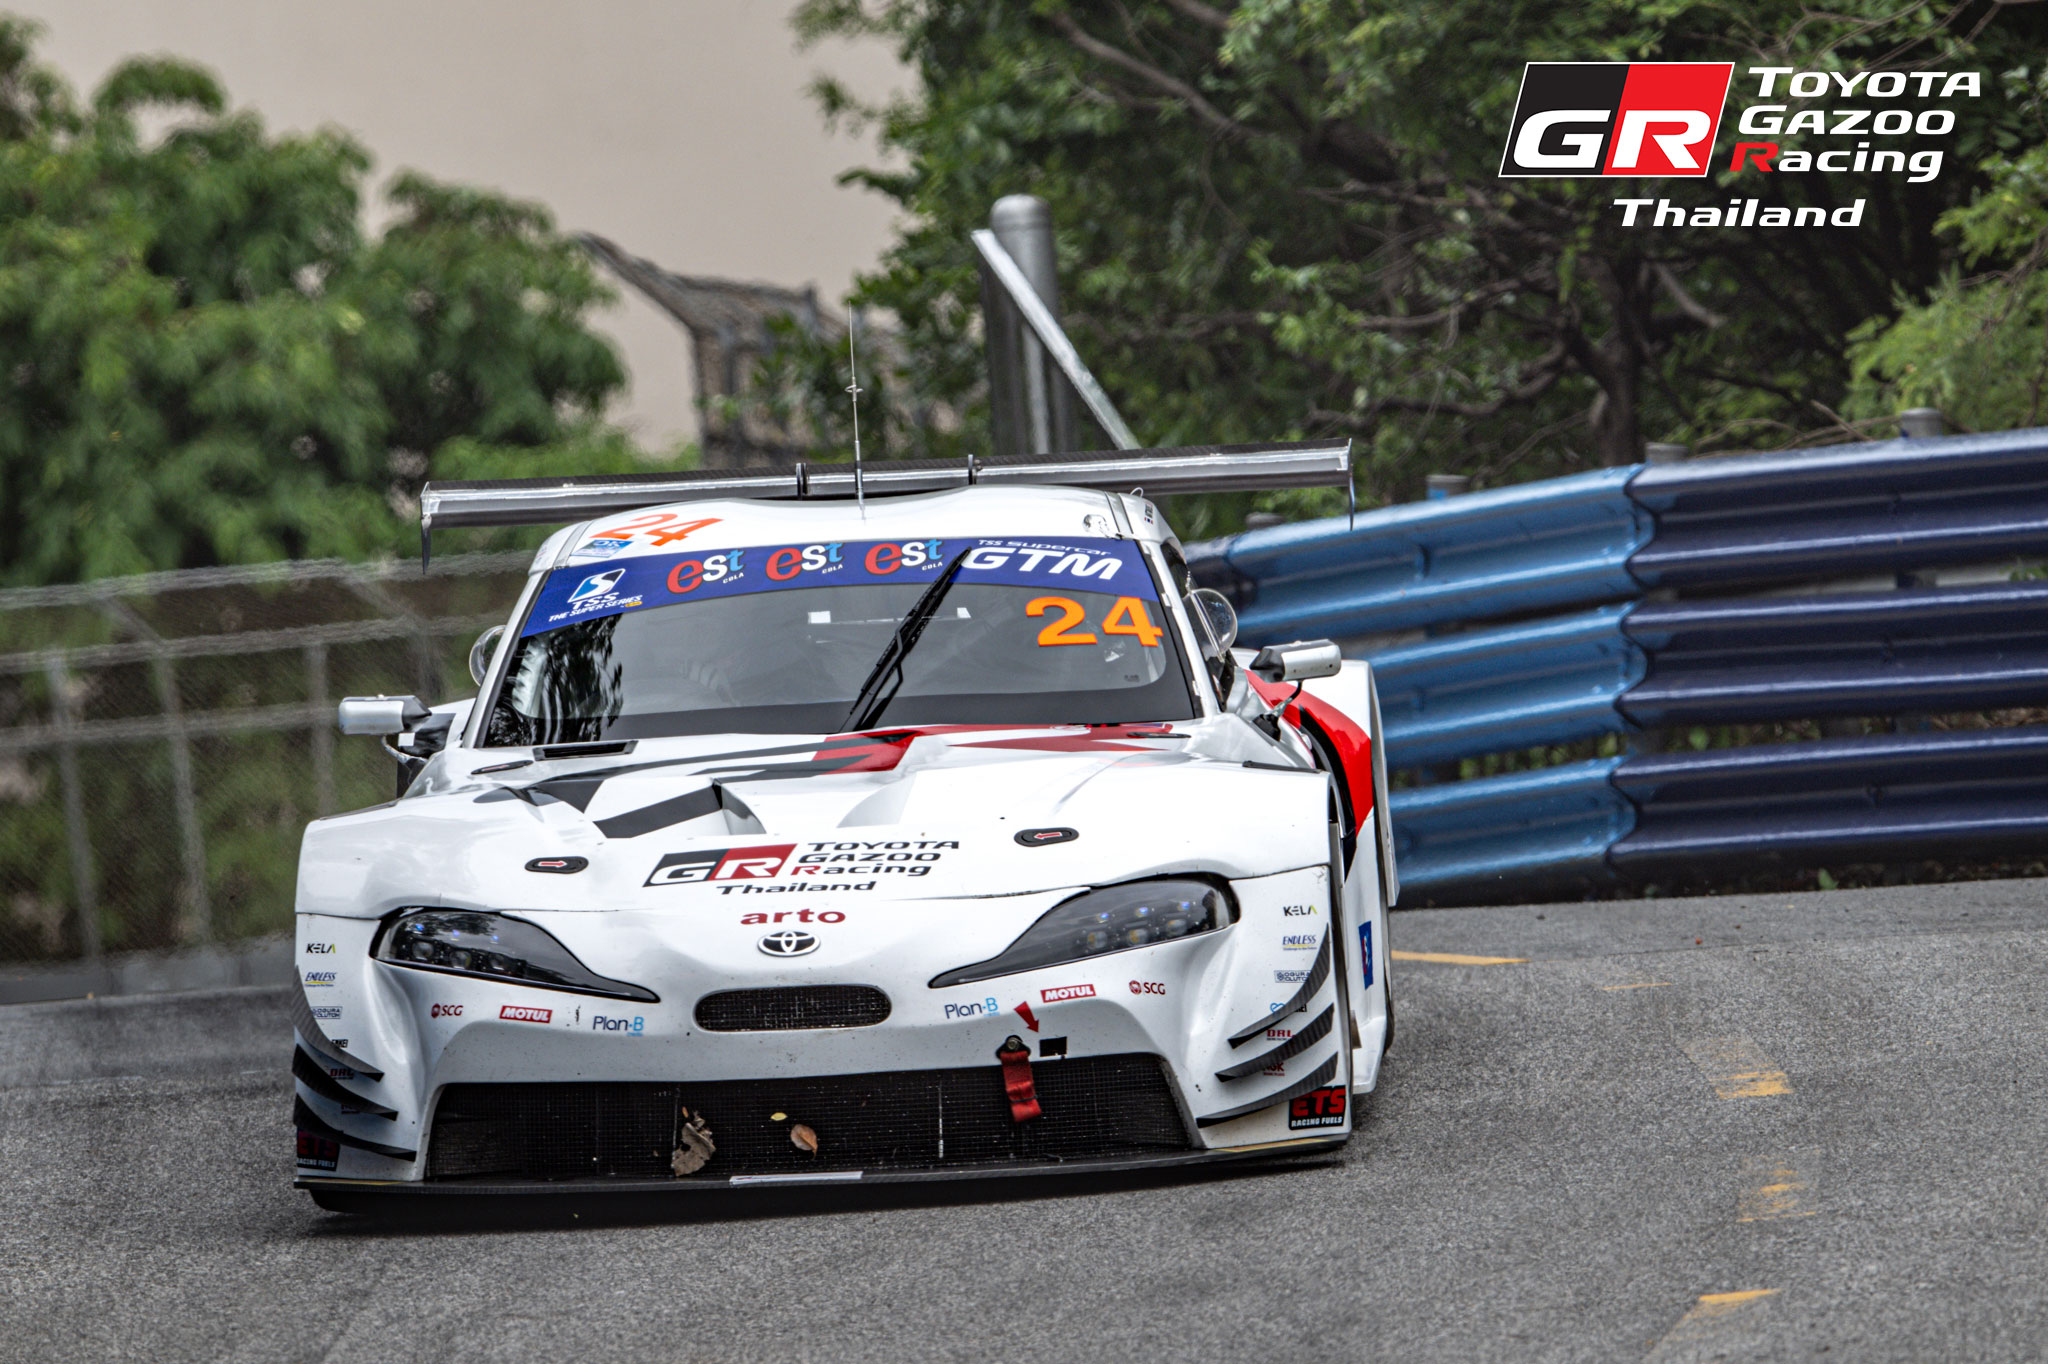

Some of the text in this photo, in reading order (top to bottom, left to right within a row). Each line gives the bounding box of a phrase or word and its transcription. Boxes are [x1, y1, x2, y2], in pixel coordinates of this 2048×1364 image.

[588, 513, 724, 547] 24
[765, 541, 846, 581] est
[864, 538, 944, 575] est
[960, 546, 1123, 580] GTM
[666, 548, 746, 594] est
[548, 611, 570, 622] THE
[569, 602, 605, 617] SUPER
[604, 595, 643, 609] SERIES
[572, 592, 620, 610] TSS
[1025, 596, 1164, 647] 24
[807, 841, 960, 852] TOYOTA
[798, 852, 942, 864] GAZOO
[649, 857, 782, 885] GR
[791, 863, 932, 877] Racing
[716, 881, 877, 895] Thailand
[740, 908, 846, 925] arto
[1283, 905, 1317, 916] KELA
[1282, 935, 1317, 945] ENDLESS
[306, 943, 336, 953] KELA
[305, 971, 337, 981] ENDLESS
[1045, 985, 1094, 1001] MOTUL
[1144, 982, 1166, 995] SCG
[441, 1004, 463, 1017] SCG
[502, 1008, 550, 1022] MOTUL
[1292, 1088, 1346, 1117] ETS
[1291, 1116, 1343, 1128] RACING FUELS
